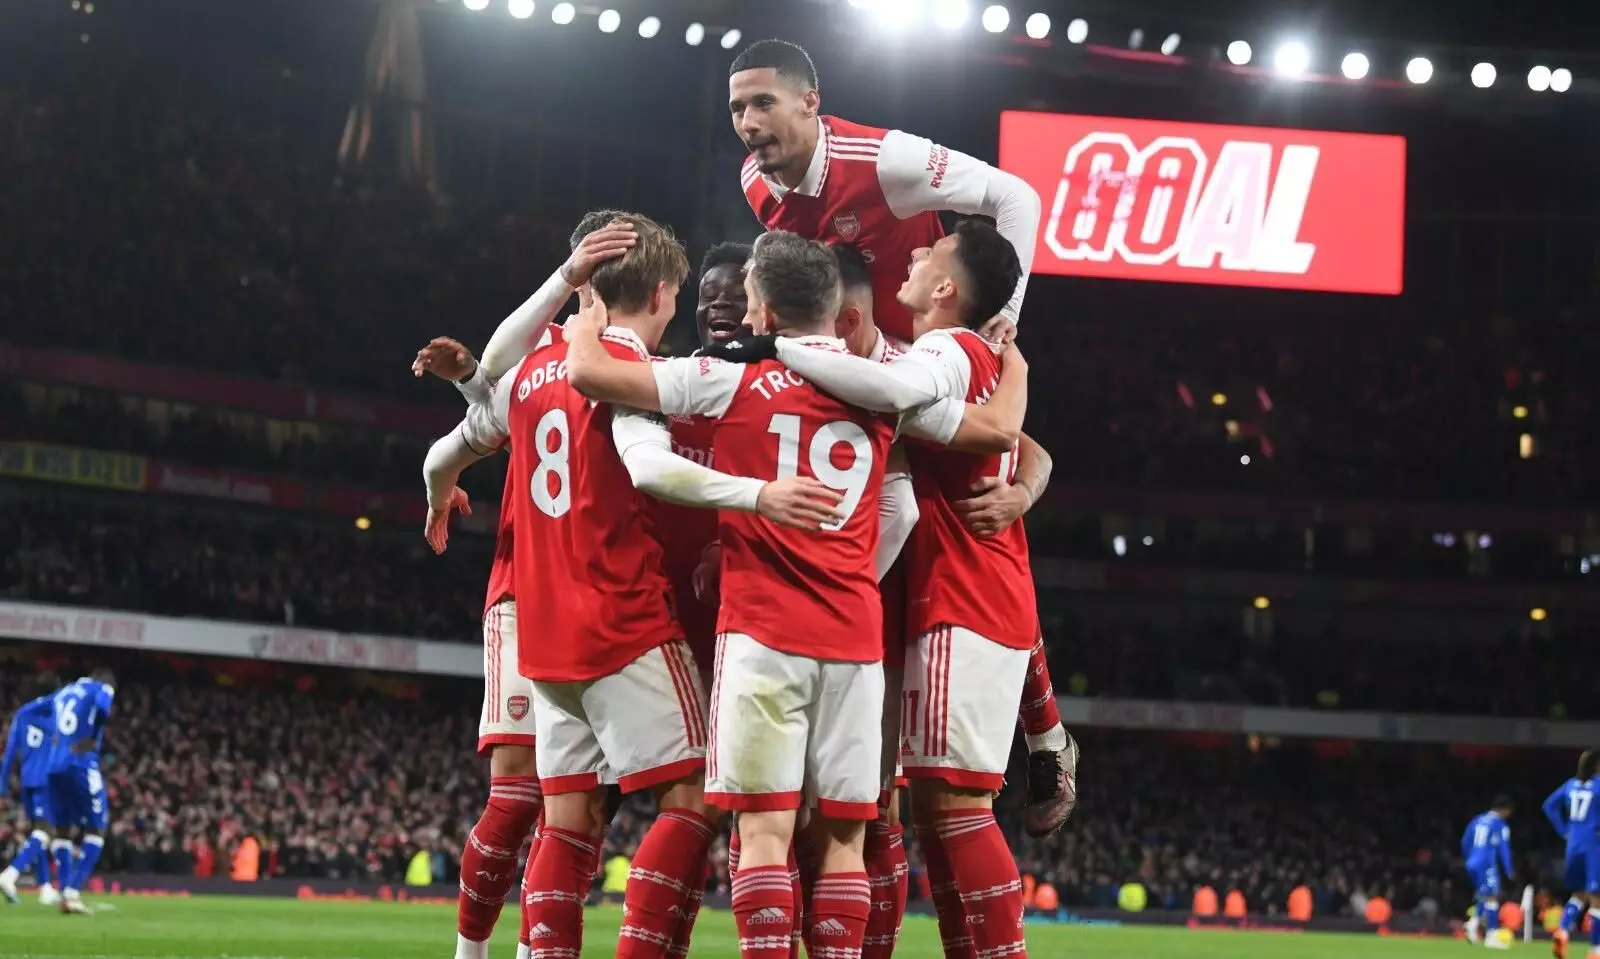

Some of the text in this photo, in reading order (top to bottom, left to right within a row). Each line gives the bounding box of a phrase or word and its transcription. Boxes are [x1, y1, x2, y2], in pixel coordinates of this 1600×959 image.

[930, 146, 949, 188] RWAND
[1045, 131, 1320, 274] GOAL
[530, 408, 571, 519] 8
[767, 413, 874, 531] 19
[1569, 790, 1593, 822] 17
[746, 916, 791, 926] adidas
